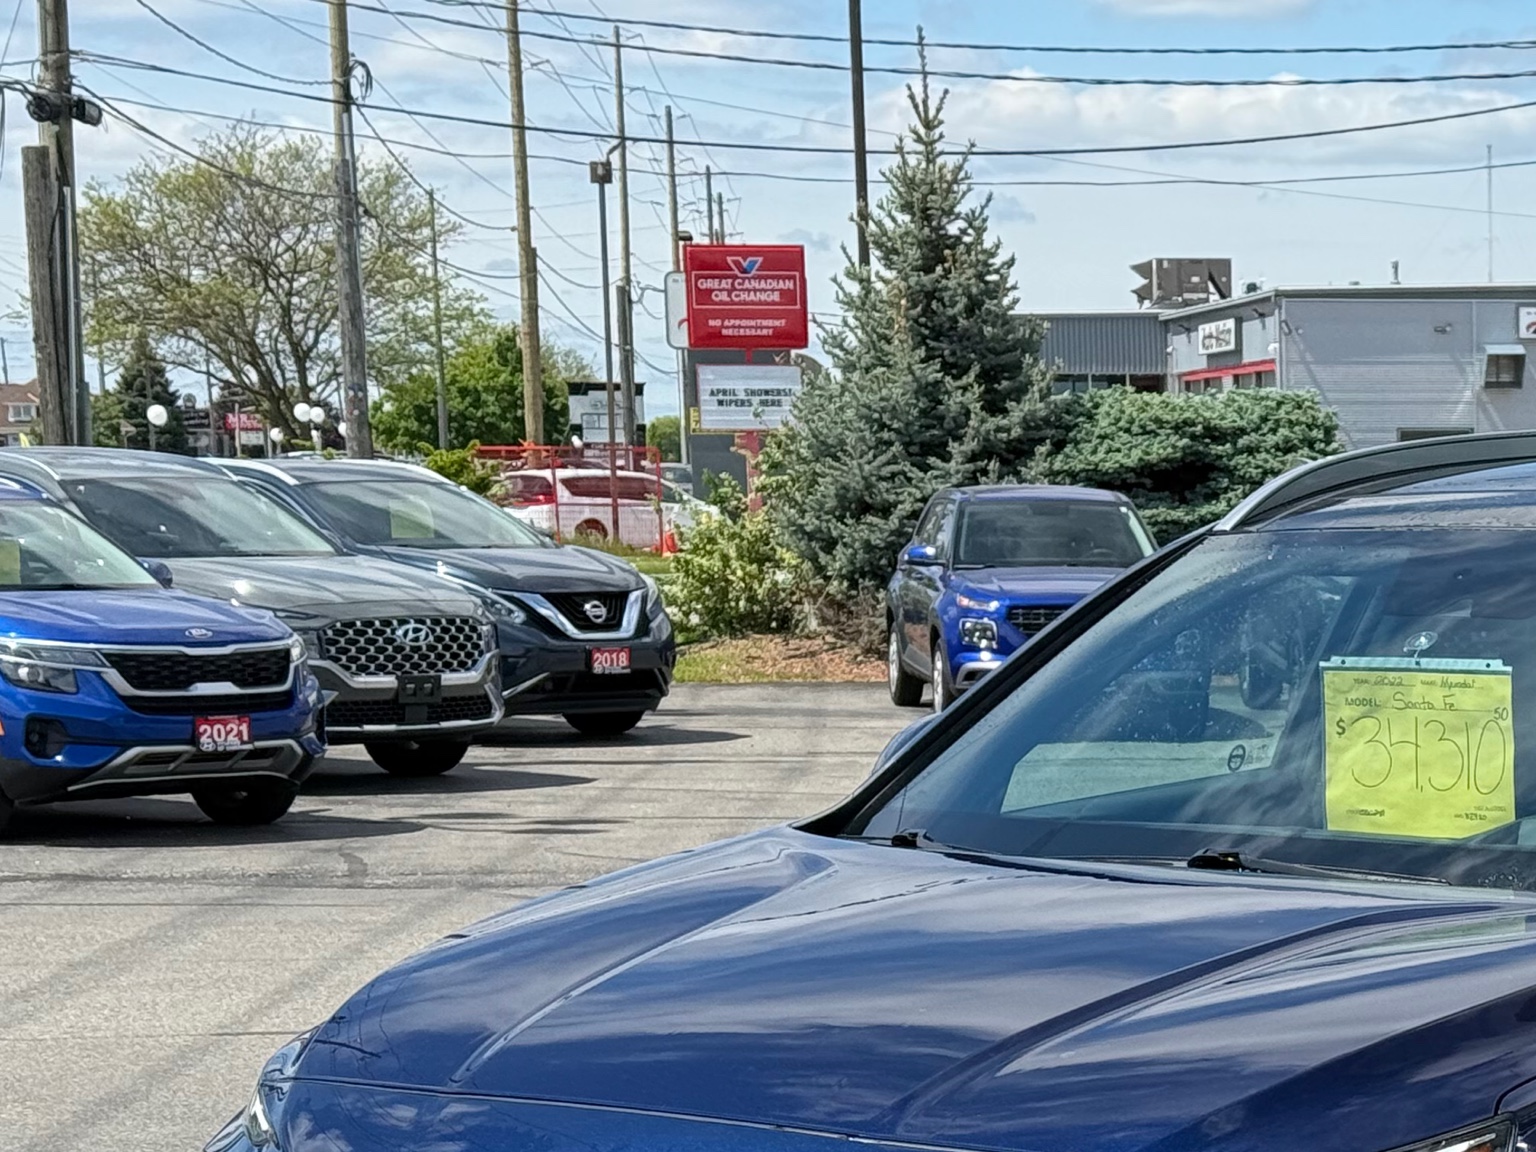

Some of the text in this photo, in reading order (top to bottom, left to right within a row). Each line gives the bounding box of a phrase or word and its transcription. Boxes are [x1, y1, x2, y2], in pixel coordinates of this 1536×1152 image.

[697, 279, 794, 290] GREAT CANADIAN
[711, 291, 780, 302] OIL CHANGE
[708, 319, 786, 327] NO APPOINTMENT
[721, 328, 774, 336] NECESSARY
[709, 388, 738, 397] APRIL
[716, 399, 783, 408] WIPERS HERE
[593, 652, 627, 667] 2018
[1392, 691, 1435, 711] Santa
[1493, 707, 1509, 722] 50
[199, 722, 249, 743] 2021
